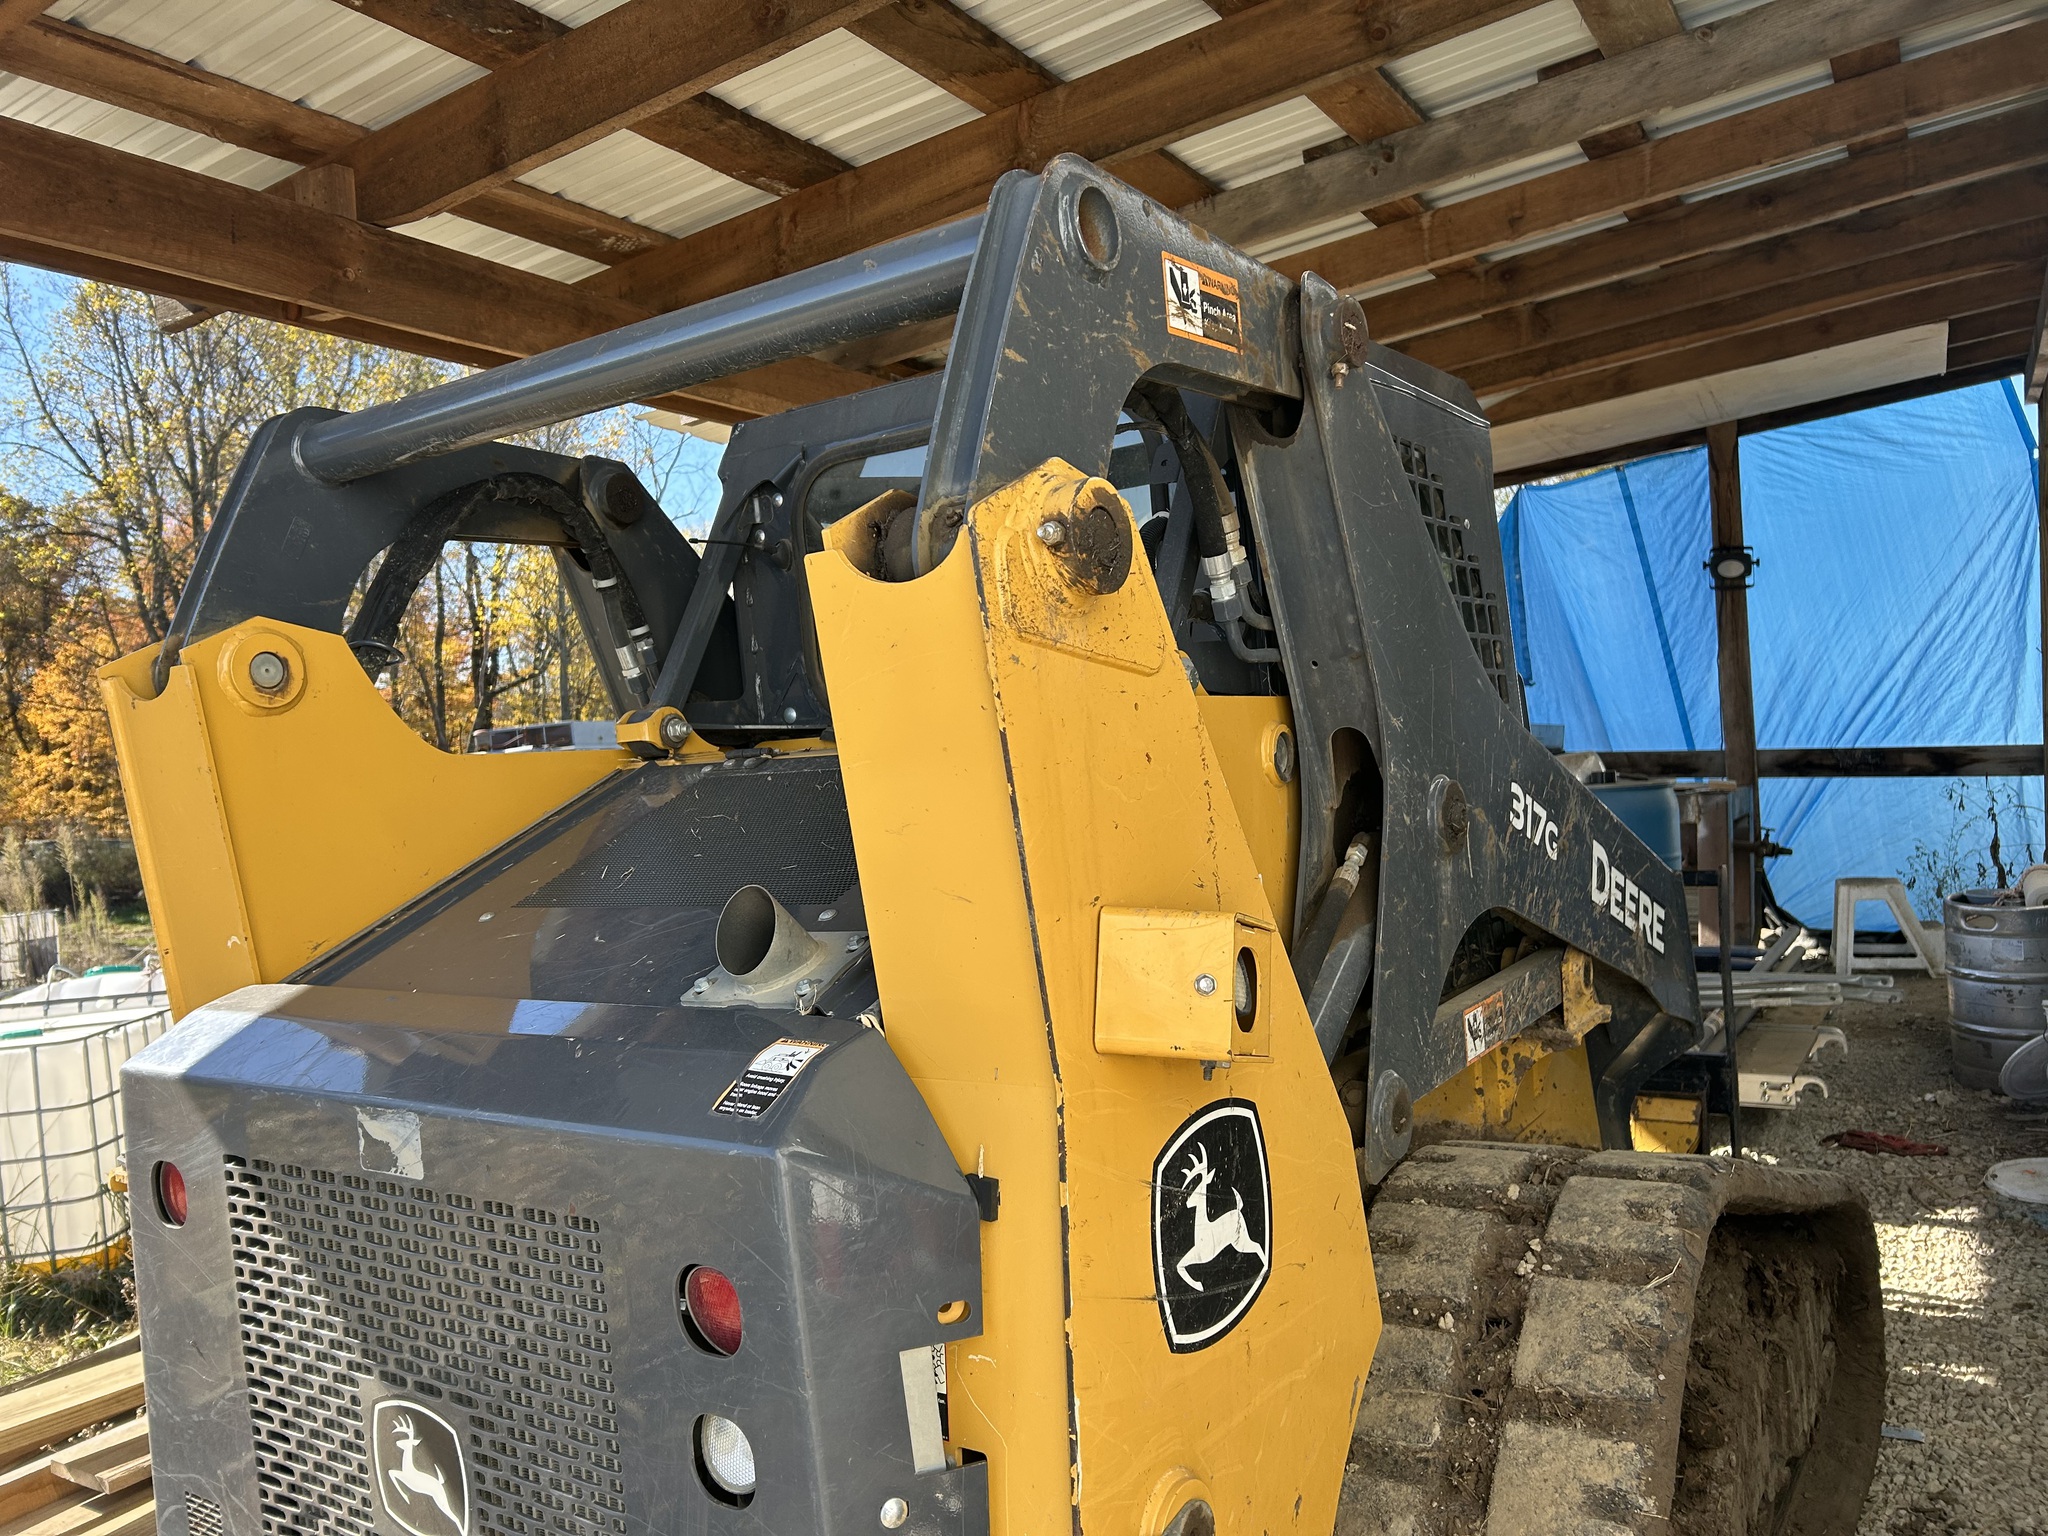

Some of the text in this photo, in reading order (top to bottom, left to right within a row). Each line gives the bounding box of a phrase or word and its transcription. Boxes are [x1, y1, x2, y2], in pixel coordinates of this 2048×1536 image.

[1203, 301, 1237, 323] Pinch Area
[1510, 781, 1559, 861] 317G
[1591, 839, 1666, 954] DEERE
